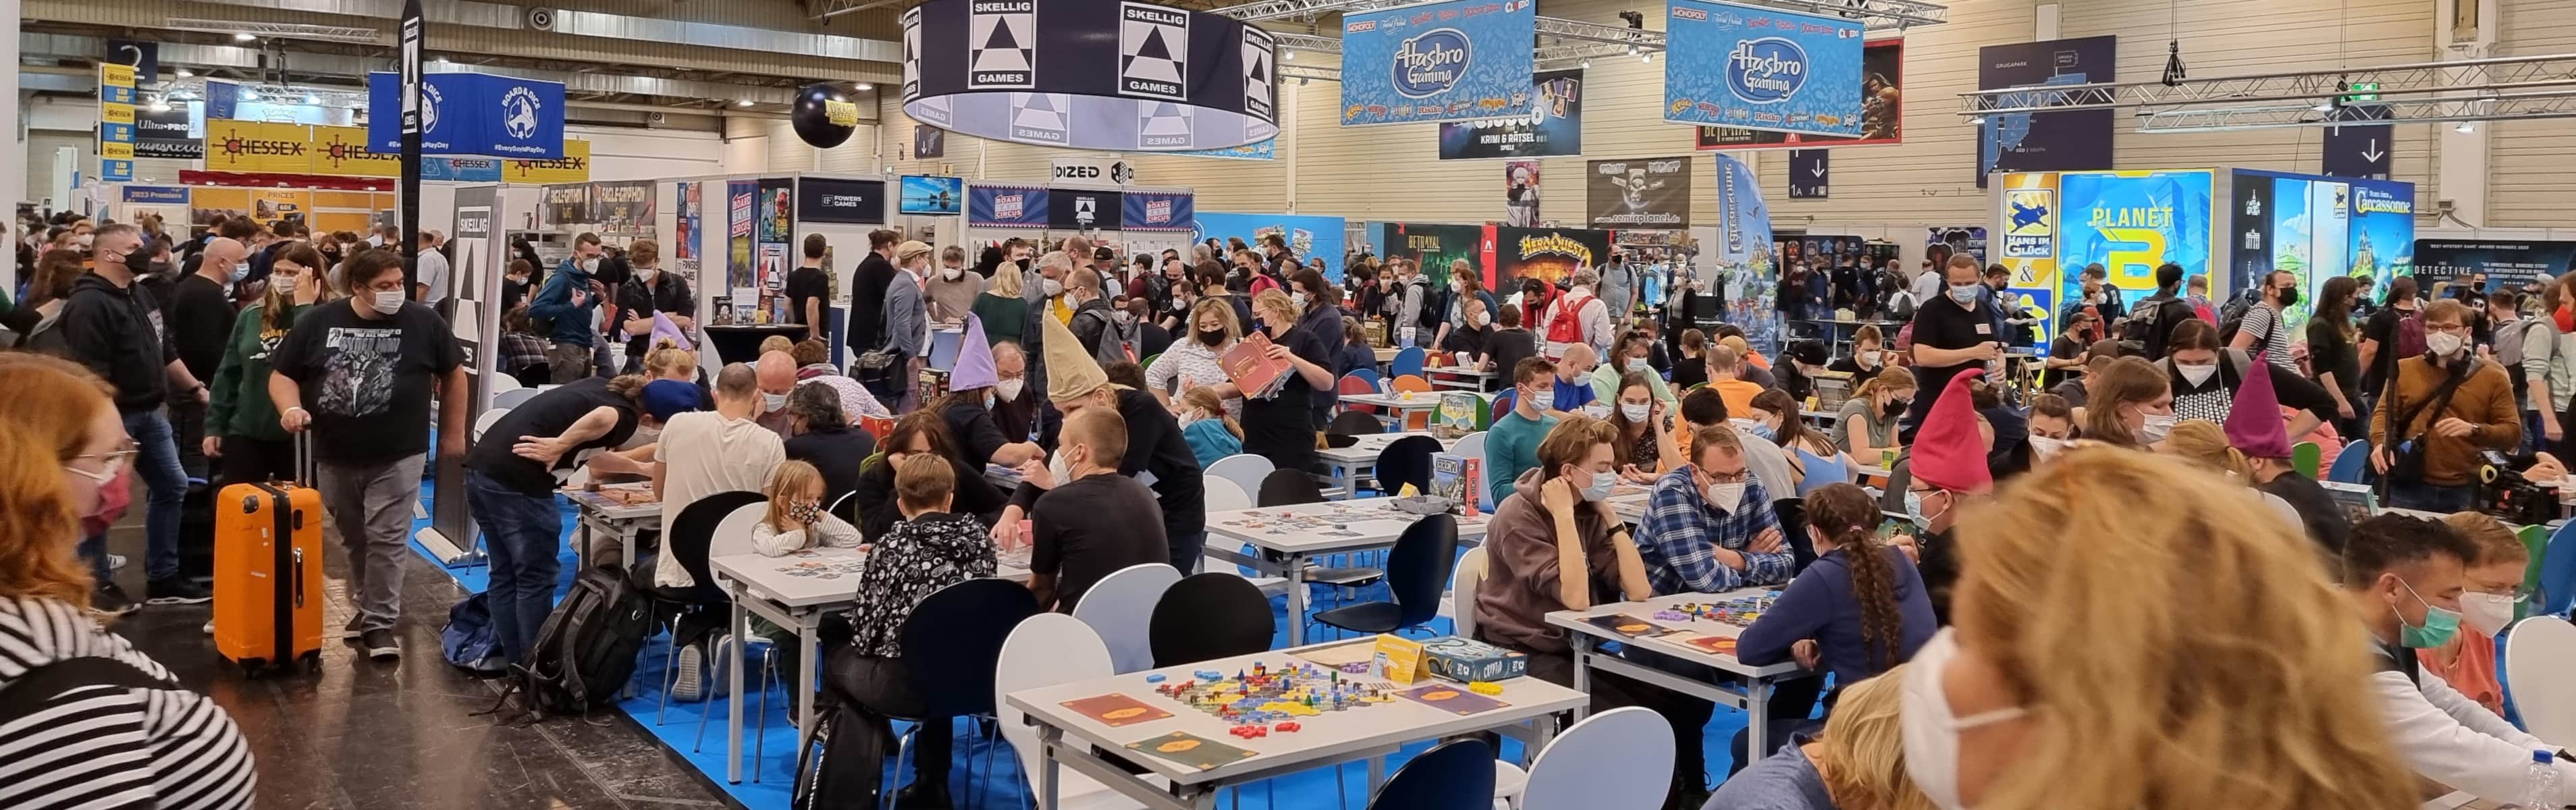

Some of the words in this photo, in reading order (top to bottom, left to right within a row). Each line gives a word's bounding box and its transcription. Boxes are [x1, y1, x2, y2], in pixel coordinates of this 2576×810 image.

[975, 3, 1031, 11] SKELLIG
[1674, 9, 1706, 20] MONOPOLY
[1127, 9, 1183, 24] SKELLIG
[1348, 22, 1375, 32] MONOPOLY
[1246, 34, 1271, 49] SKELLIG
[1397, 43, 1464, 72] Hasbro
[1732, 43, 1801, 78] Hasbro
[978, 74, 1024, 82] GAMES
[1407, 66, 1451, 88] Gaming
[1744, 70, 1790, 96] Gaming
[428, 84, 442, 104] DICE
[1130, 81, 1177, 94] GAMES
[502, 86, 522, 107] BOARD
[528, 90, 541, 111] DICE
[1250, 101, 1269, 115] GAMES
[1756, 112, 1780, 122] Risiko
[1480, 135, 1500, 144] KRIMI
[1501, 134, 1507, 142] &
[1508, 131, 1534, 142] RÄTSEL
[225, 139, 303, 156] CHESSEX
[452, 159, 491, 169] CHESSEX
[1055, 166, 1100, 178] DIZED
[1791, 184, 1802, 196] 1A
[733, 196, 751, 210] BOARD
[2355, 188, 2411, 214] Carcassonne
[733, 207, 751, 222] GAME
[2093, 207, 2173, 227] PLANET
[460, 217, 487, 233] SKELLIG
[733, 221, 751, 234] CIRCUS
[1408, 235, 1441, 252] BETRAYAL
[2005, 241, 2049, 256] GLÜCK
[2008, 236, 2036, 246] HANS
[2037, 237, 2049, 246] IM
[2098, 227, 2166, 290] B
[2020, 265, 2035, 283] &
[2415, 266, 2471, 275] DETECTIVE
[1438, 458, 1457, 472] BREW
[1484, 660, 1502, 678] CRYPTID
